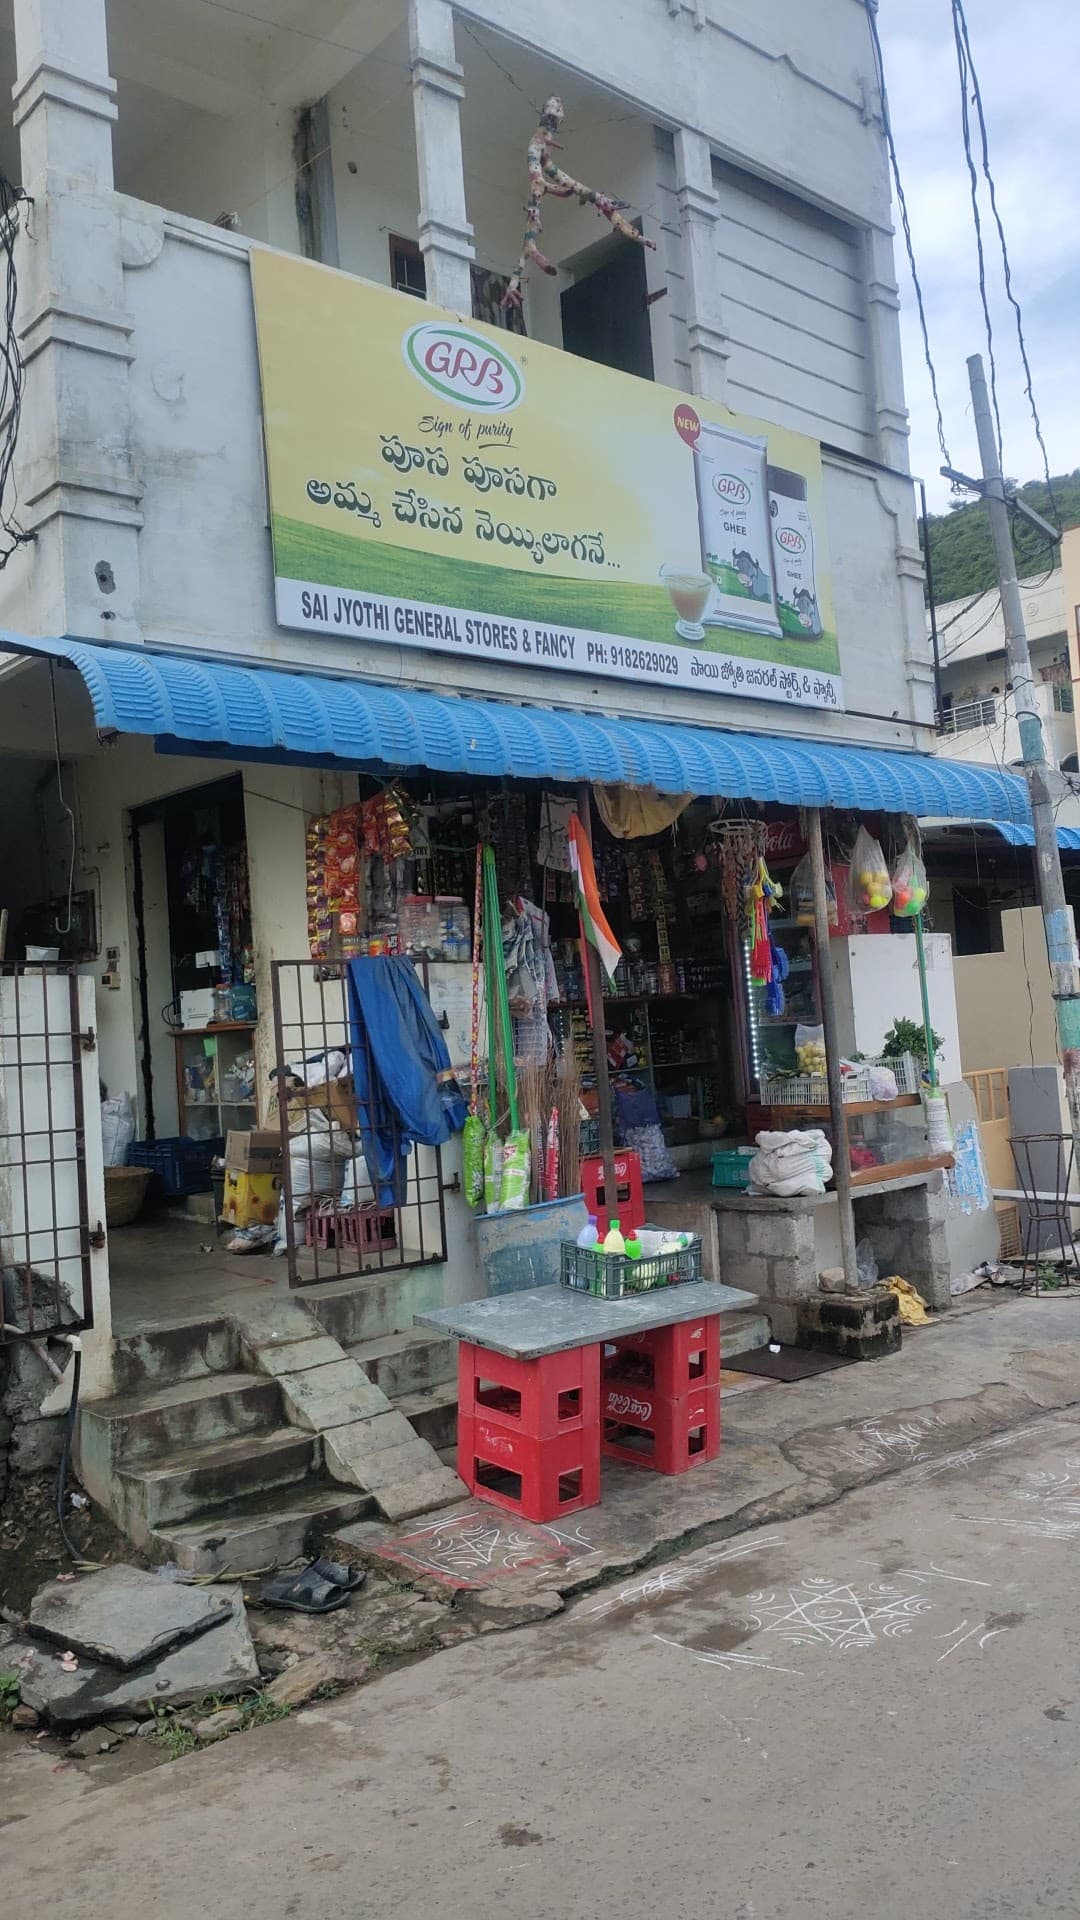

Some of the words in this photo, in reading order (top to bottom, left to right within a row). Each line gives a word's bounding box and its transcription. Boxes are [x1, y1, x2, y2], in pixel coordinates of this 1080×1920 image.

[425, 341, 503, 394] GRB
[418, 415, 453, 438] Sign
[459, 418, 472, 440] of
[476, 421, 513, 444] purity
[676, 416, 699, 433] NEW
[379, 434, 450, 477] పూస
[462, 456, 557, 501] పూసగా
[306, 478, 382, 529] అమ్మ
[392, 488, 463, 535] చేసిన
[718, 478, 745, 500] GRB
[723, 522, 747, 536] GHEE
[301, 590, 329, 621] SAI
[333, 597, 390, 631] JYOTHI
[394, 606, 462, 642] GENERAL
[465, 618, 518, 651] STORES
[522, 628, 531, 652] &
[535, 630, 575, 659] FANCY
[587, 641, 608, 665] PH:
[610, 646, 679, 675] 9182629029
[690, 656, 719, 679] సాయి
[720, 660, 744, 688] జ్యోతి
[746, 667, 778, 688] జనరల్
[803, 675, 811, 693] &
